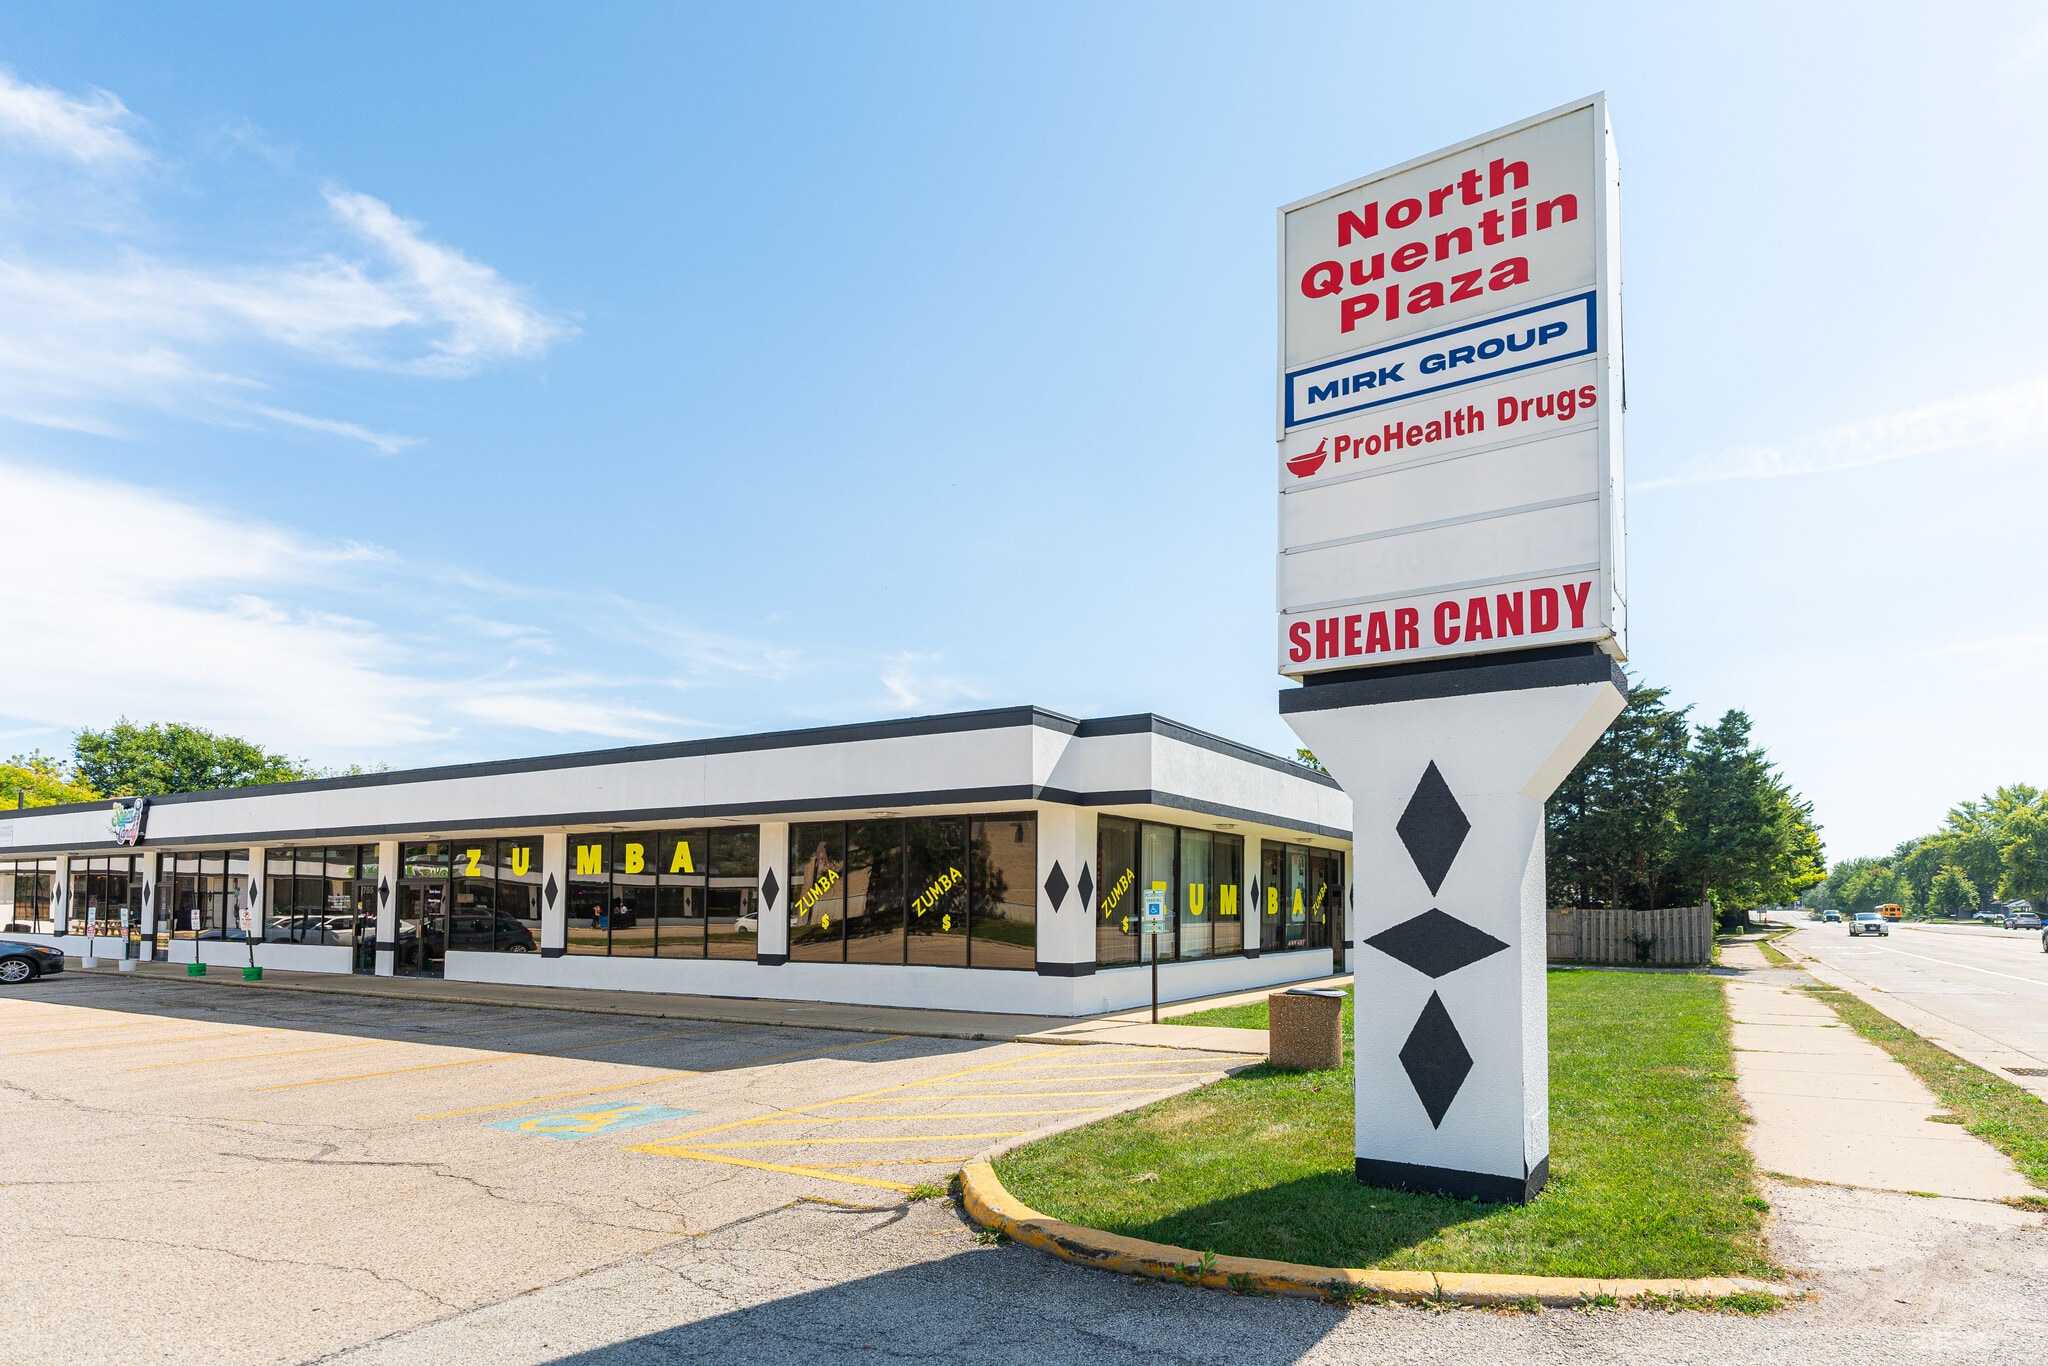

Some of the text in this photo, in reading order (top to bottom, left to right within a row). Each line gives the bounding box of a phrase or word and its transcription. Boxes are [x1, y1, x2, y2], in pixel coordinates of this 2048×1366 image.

[1337, 157, 1529, 249] North
[1300, 193, 1578, 299] Quentin
[1341, 256, 1531, 334] Plaza
[1307, 321, 1569, 405] MIRK GROUP
[1334, 385, 1598, 463] ProHealth Drugs
[1288, 581, 1592, 663] SHEAR CANDY
[794, 869, 840, 917] ZUMBA
[911, 866, 963, 918] ZUMBA
[1100, 867, 1136, 919] ZUMBA
[1312, 881, 1329, 917] ZUMBA
[820, 913, 830, 930] $
[941, 913, 952, 931] $
[1121, 915, 1130, 933] $
